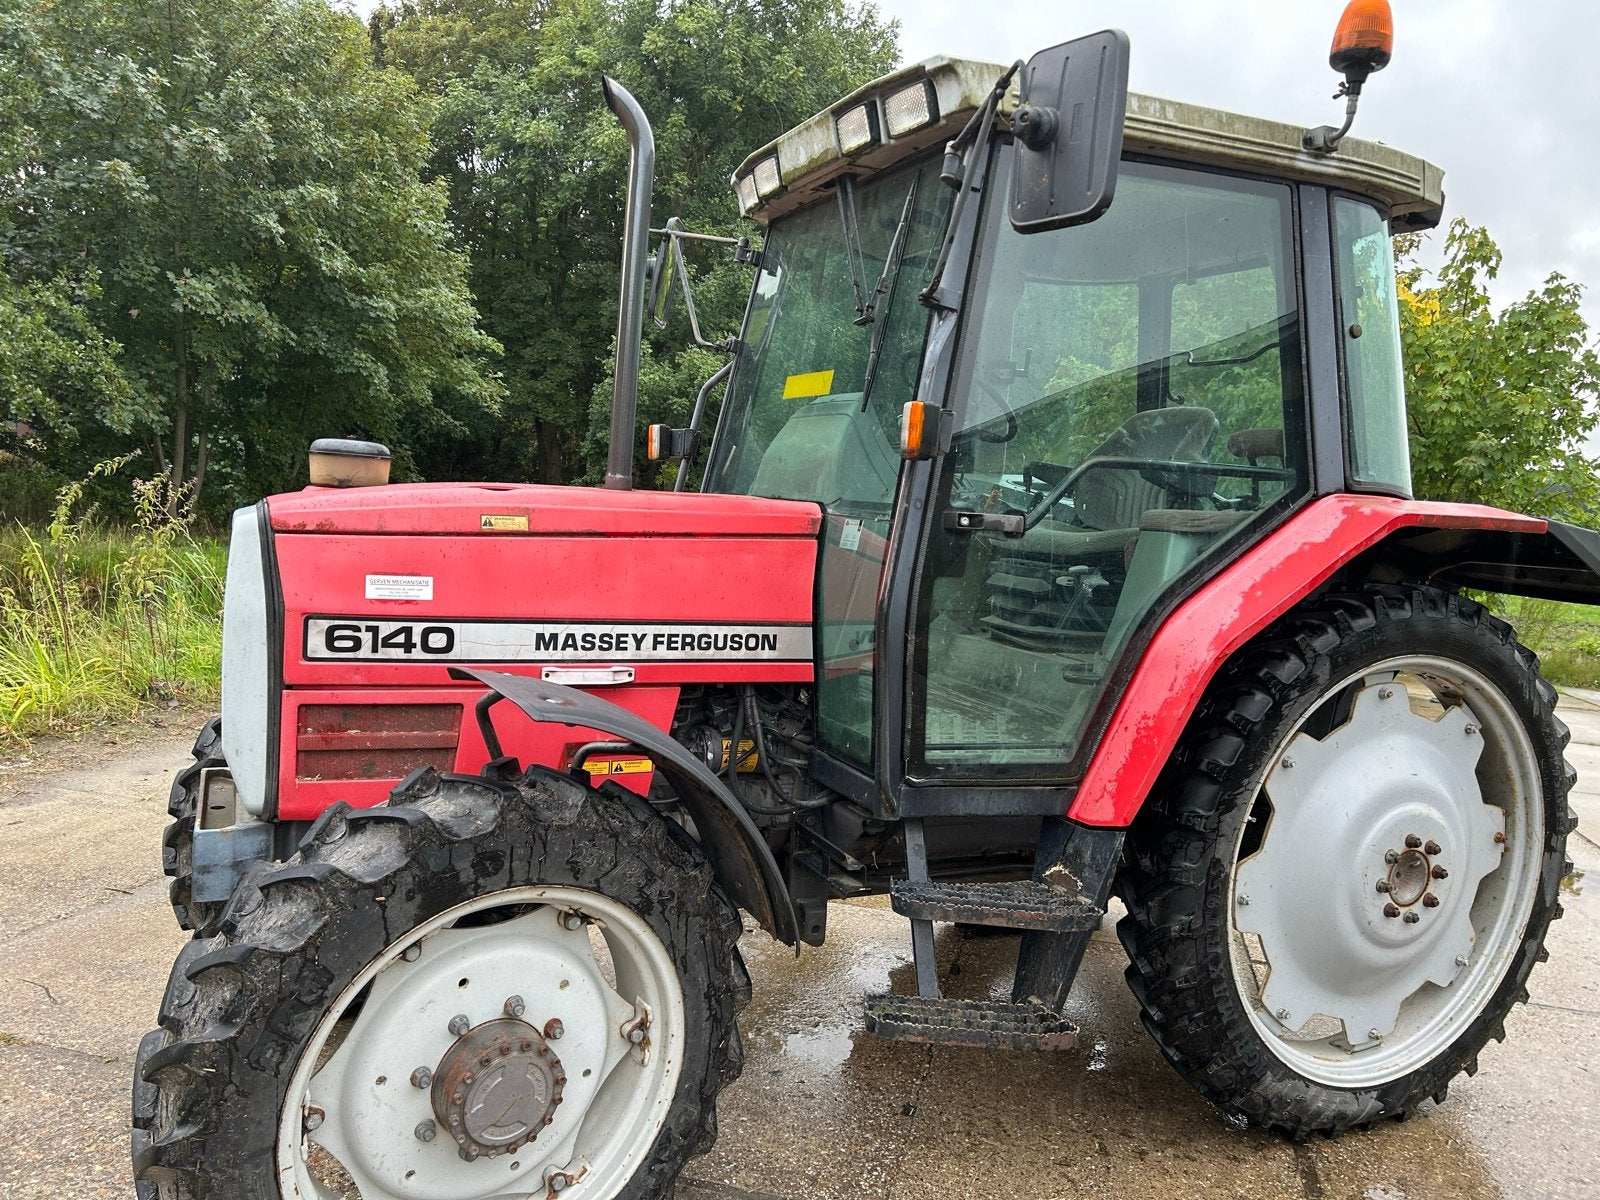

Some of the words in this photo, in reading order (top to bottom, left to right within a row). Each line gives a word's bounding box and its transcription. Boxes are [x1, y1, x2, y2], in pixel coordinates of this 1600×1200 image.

[325, 624, 455, 654] 6140
[534, 632, 648, 651] MASSEY
[652, 633, 778, 651] FERGUSON
